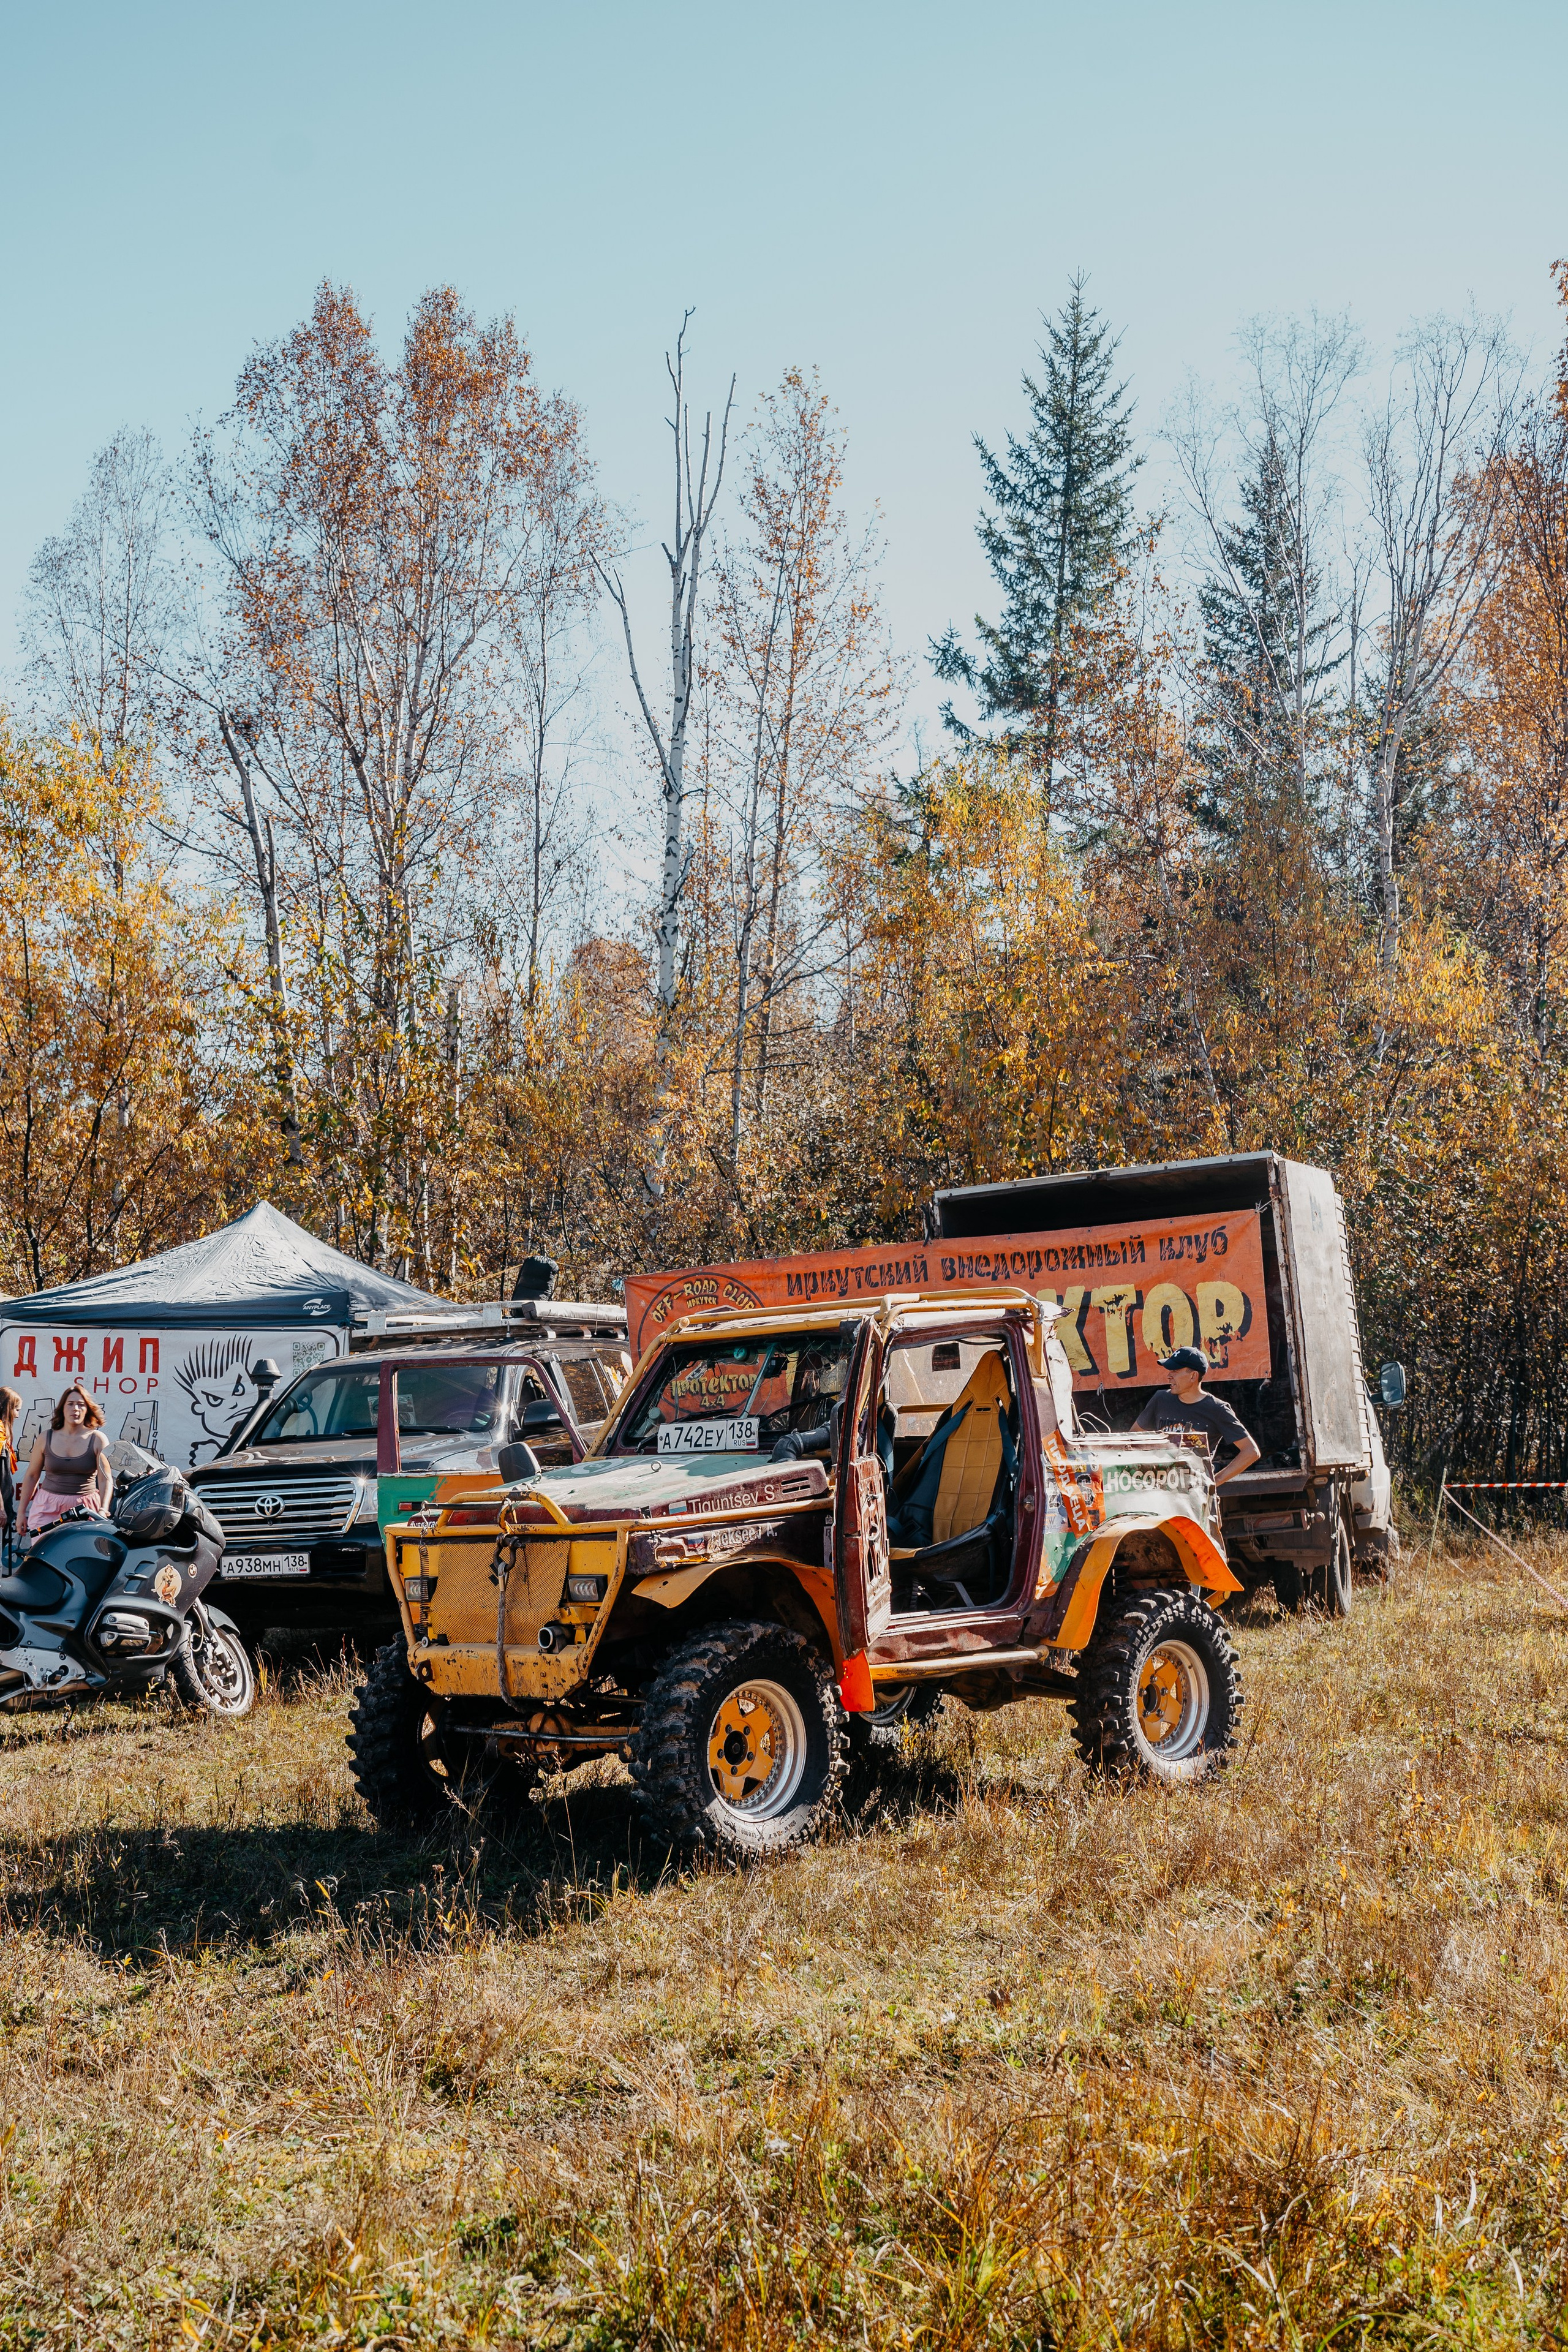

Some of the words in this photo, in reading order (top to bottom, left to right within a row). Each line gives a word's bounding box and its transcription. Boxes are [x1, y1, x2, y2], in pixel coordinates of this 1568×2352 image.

[13, 1336, 160, 1378] ДЖИП
[74, 1376, 159, 1395] SHOP
[728, 1421, 753, 1439] 138
[764, 1484, 775, 1501] S
[284, 1555, 304, 1567] 138
